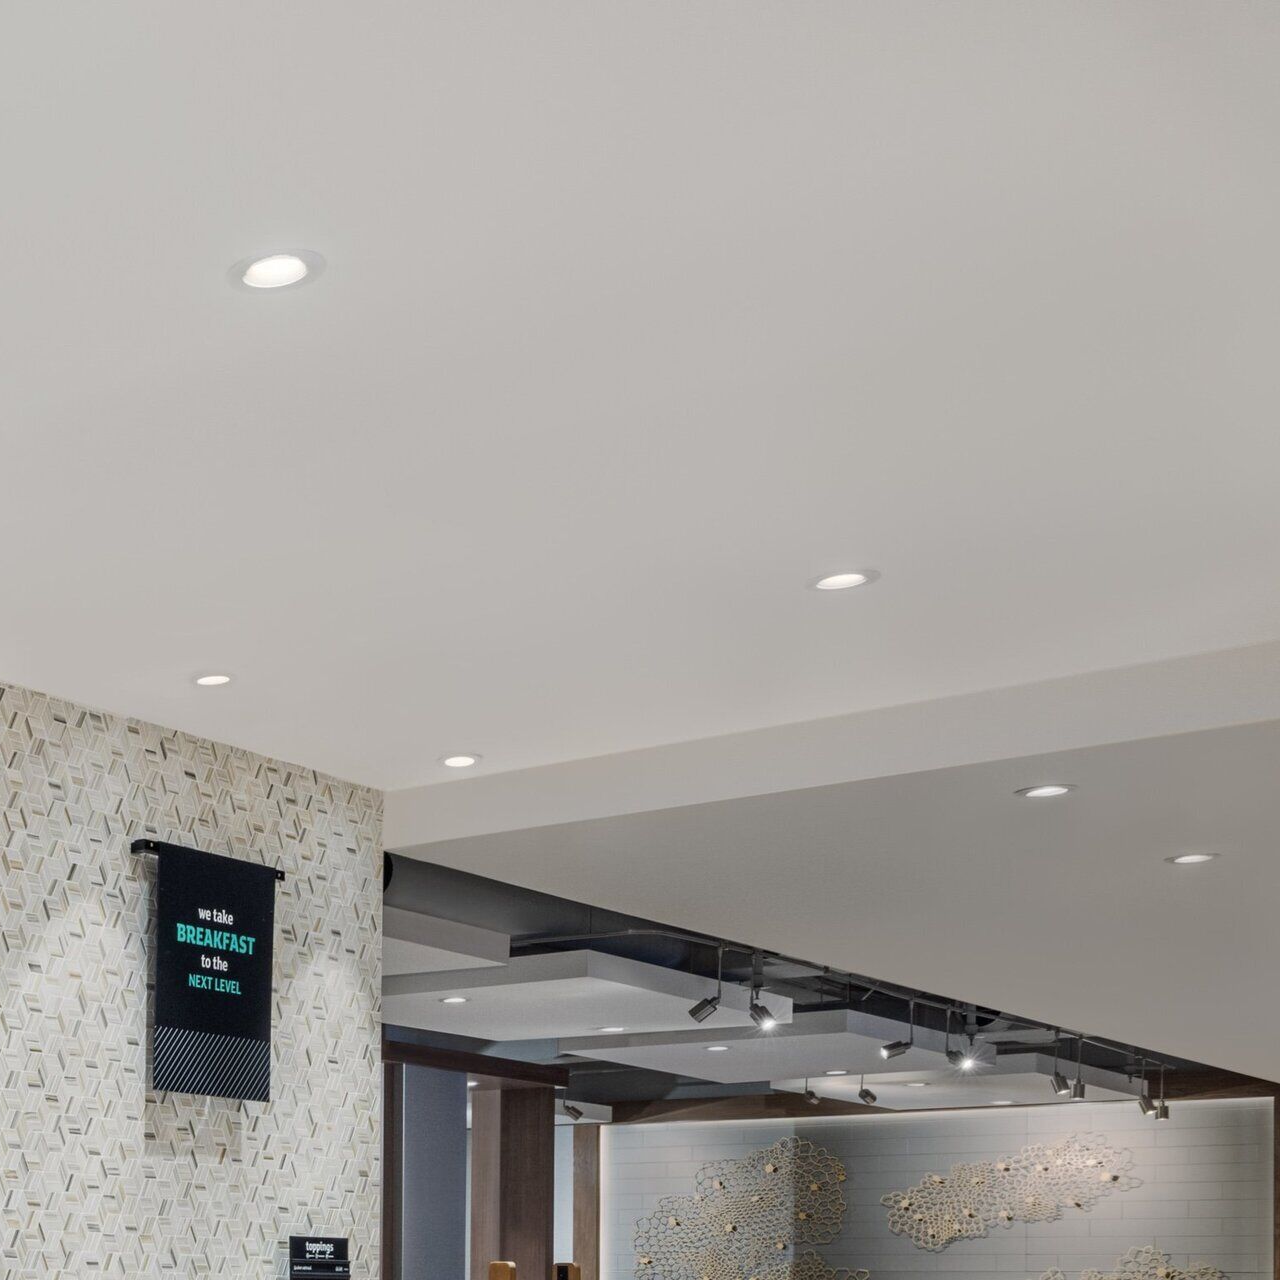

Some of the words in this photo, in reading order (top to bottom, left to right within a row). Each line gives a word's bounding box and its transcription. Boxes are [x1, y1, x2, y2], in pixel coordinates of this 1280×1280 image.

[198, 908, 212, 920] we
[213, 909, 234, 925] take
[176, 923, 255, 955] BREAKFAST
[201, 954, 212, 969] to
[213, 956, 228, 971] the
[189, 973, 213, 990] NEXT
[214, 977, 242, 995] LEVEL
[305, 1241, 334, 1253] toppings
